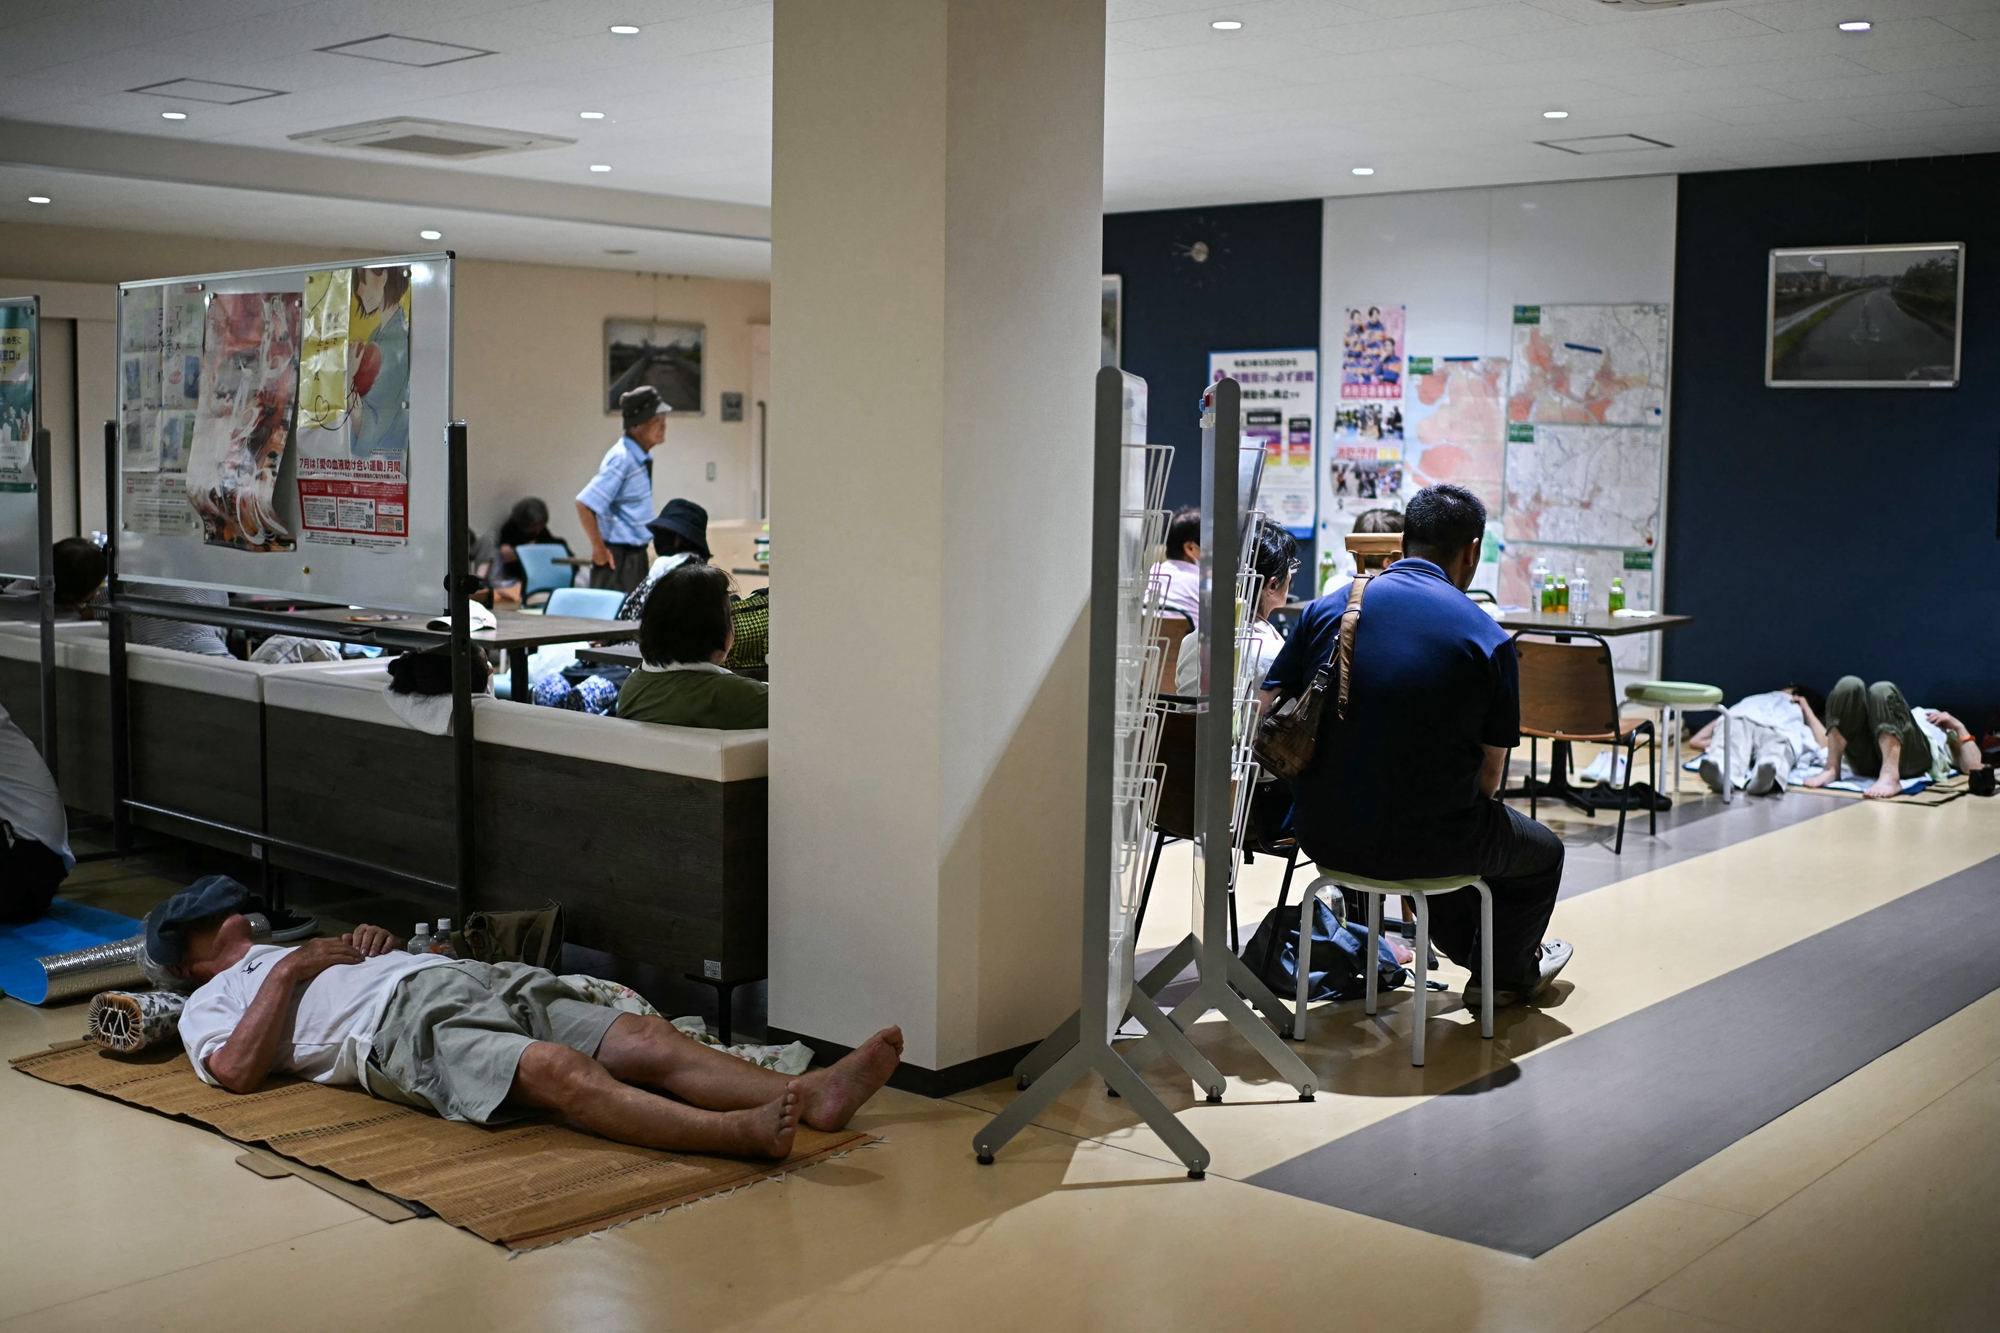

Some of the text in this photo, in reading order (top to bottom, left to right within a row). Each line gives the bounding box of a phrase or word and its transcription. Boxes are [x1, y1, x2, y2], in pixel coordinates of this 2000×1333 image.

[299, 458, 401, 473] 7月は「愛の血液助け合い運動」月間
